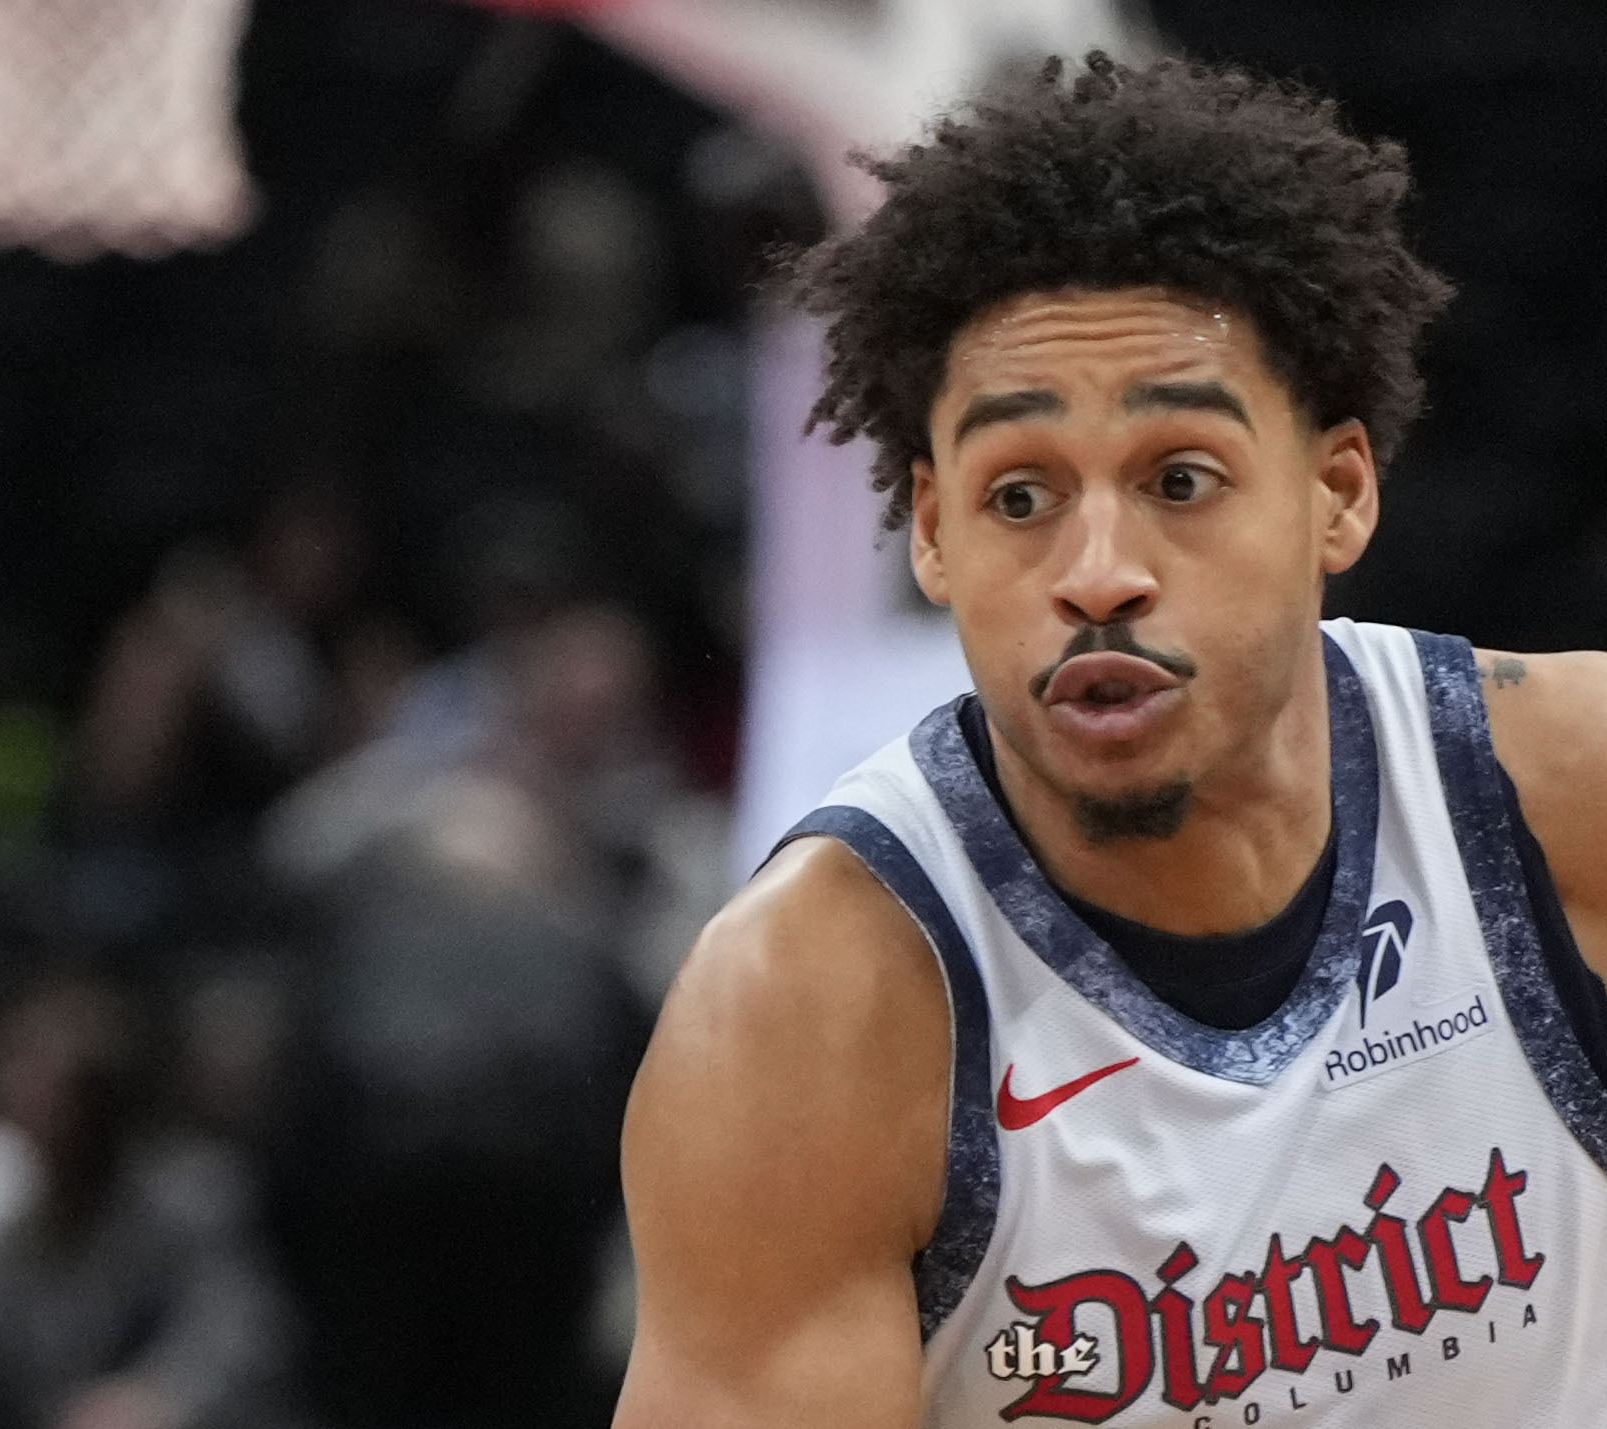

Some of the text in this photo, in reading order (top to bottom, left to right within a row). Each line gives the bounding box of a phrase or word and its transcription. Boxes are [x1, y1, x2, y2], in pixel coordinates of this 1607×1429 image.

[1324, 995, 1489, 1083] Robinhood
[984, 1146, 1546, 1426] the District
